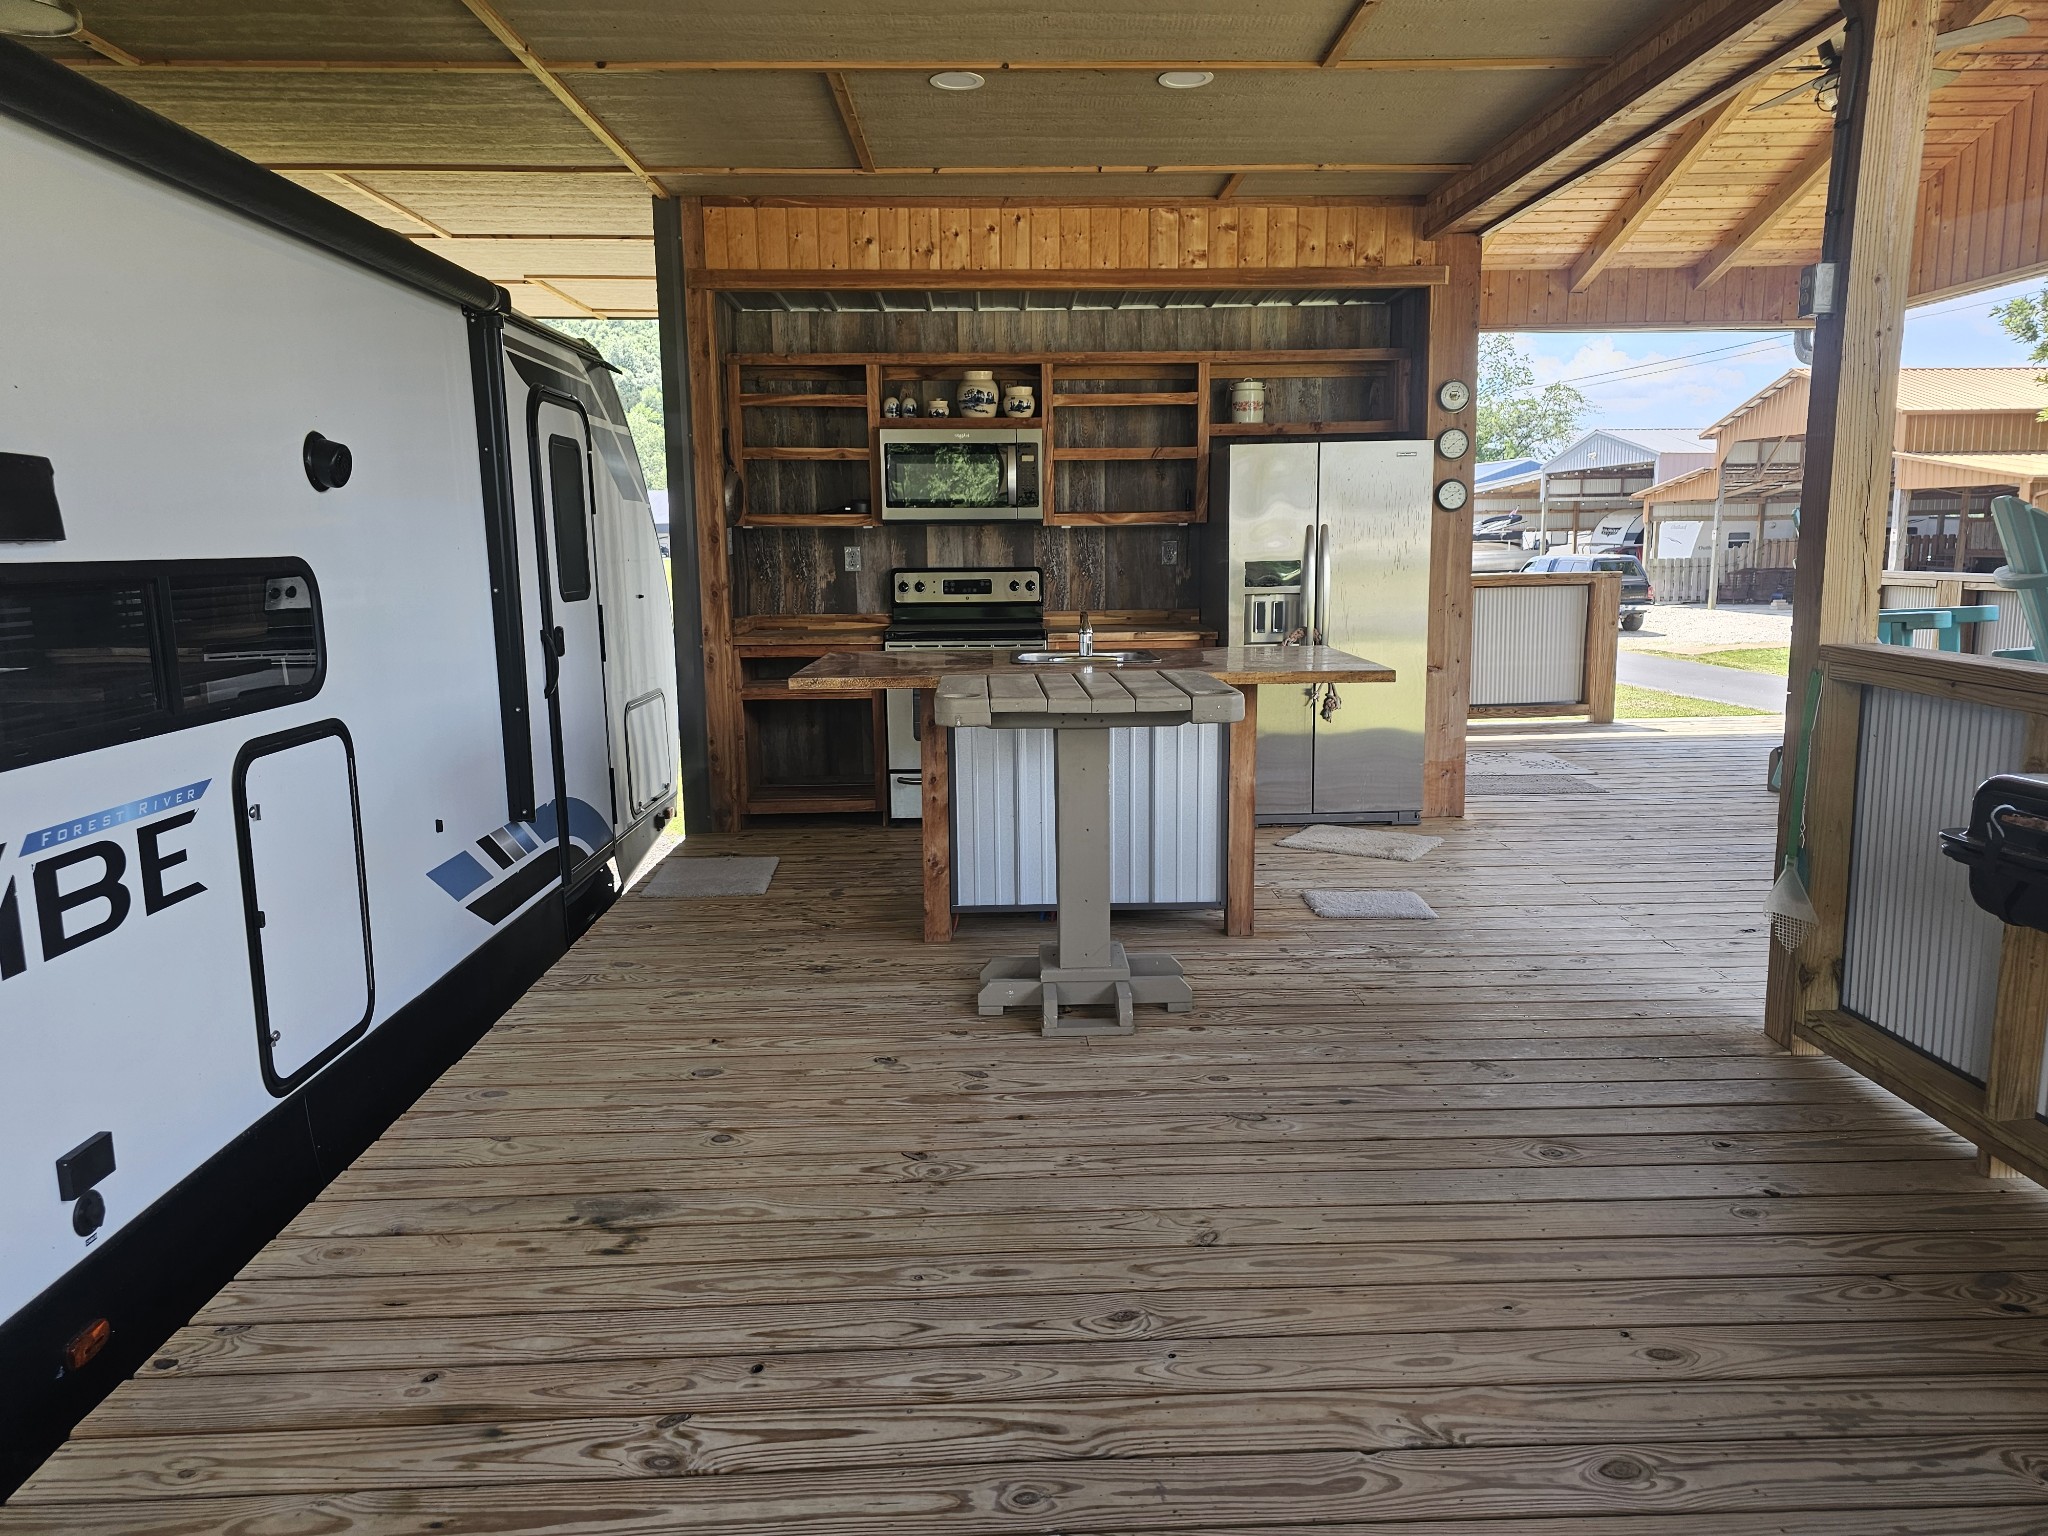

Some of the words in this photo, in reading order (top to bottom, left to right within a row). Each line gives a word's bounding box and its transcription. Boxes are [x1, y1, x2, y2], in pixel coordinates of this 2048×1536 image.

[41, 810, 124, 847] FOREST
[138, 788, 195, 815] RIVER
[0, 808, 208, 981] IBE
